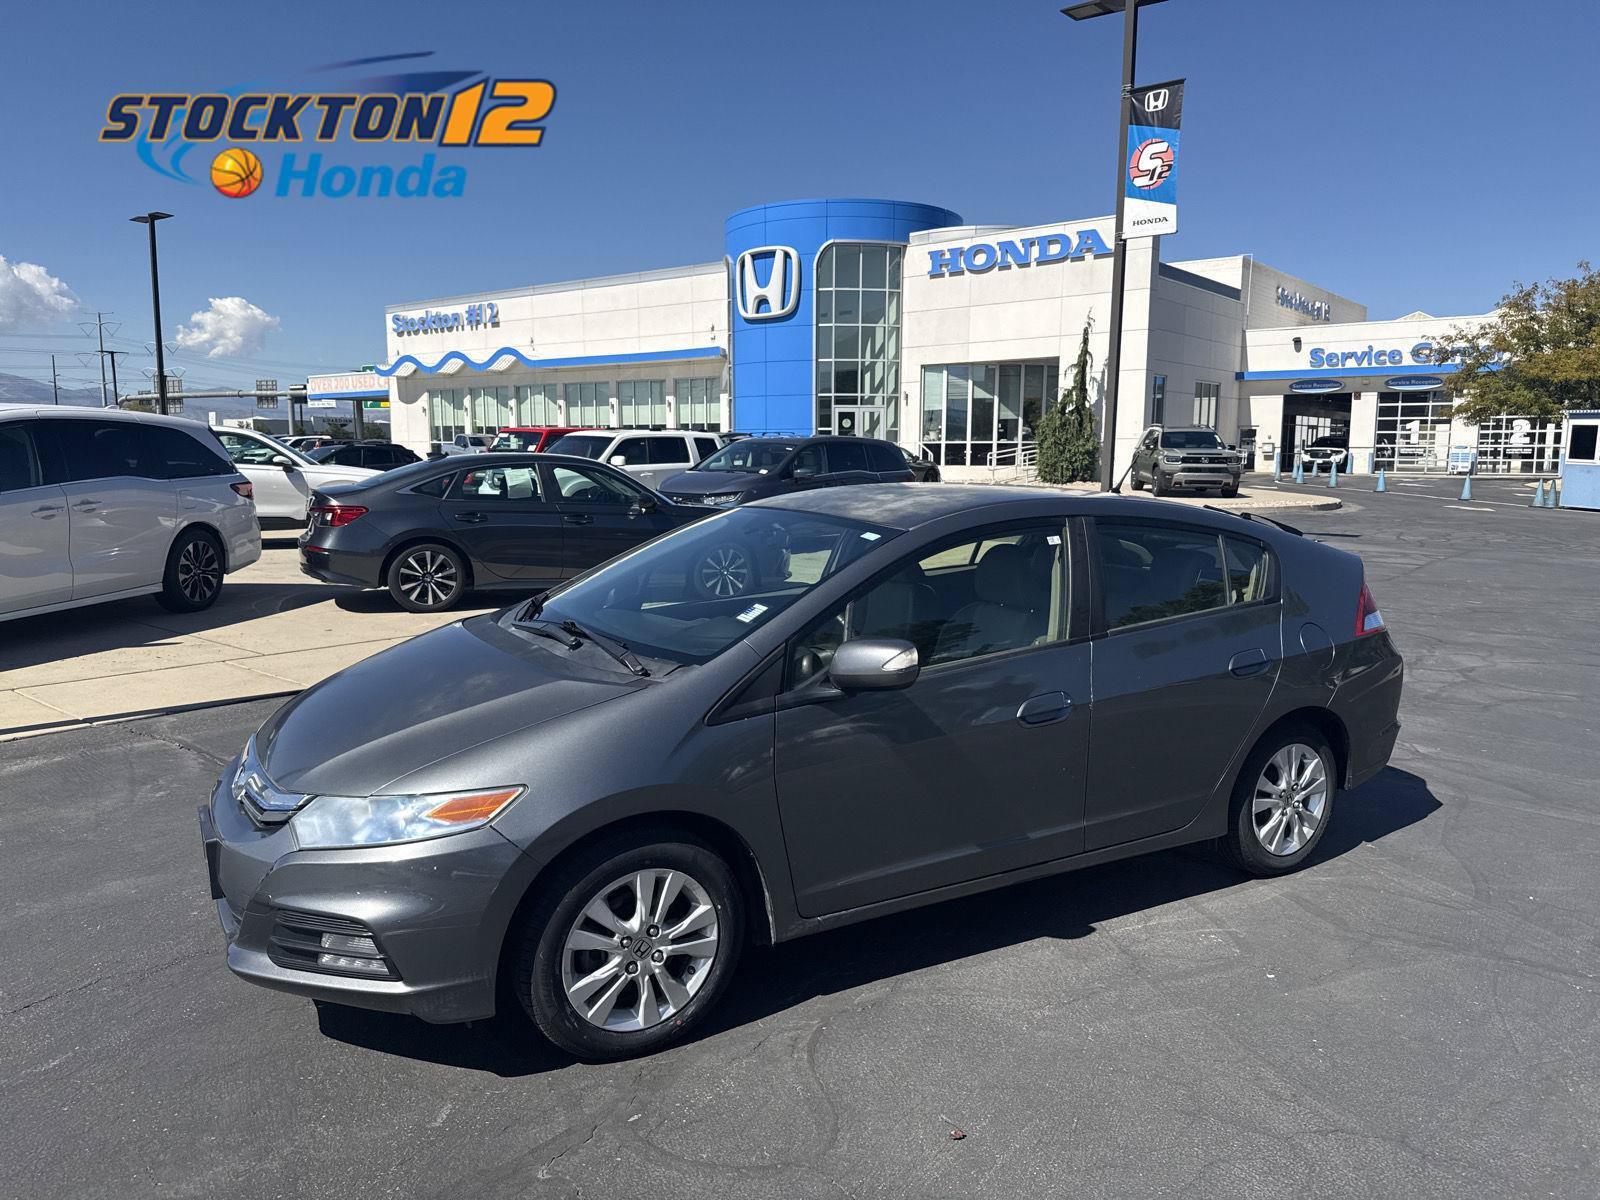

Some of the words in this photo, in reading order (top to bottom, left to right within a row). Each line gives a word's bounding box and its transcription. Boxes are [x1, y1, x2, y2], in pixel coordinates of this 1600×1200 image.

[1132, 216, 1169, 227] HONDA
[927, 229, 1113, 277] HONDA
[392, 311, 463, 334] Stockton
[466, 303, 498, 327] #12
[1310, 344, 1402, 368] Service
[1405, 420, 1420, 444] 1
[1509, 419, 1531, 444] 2
